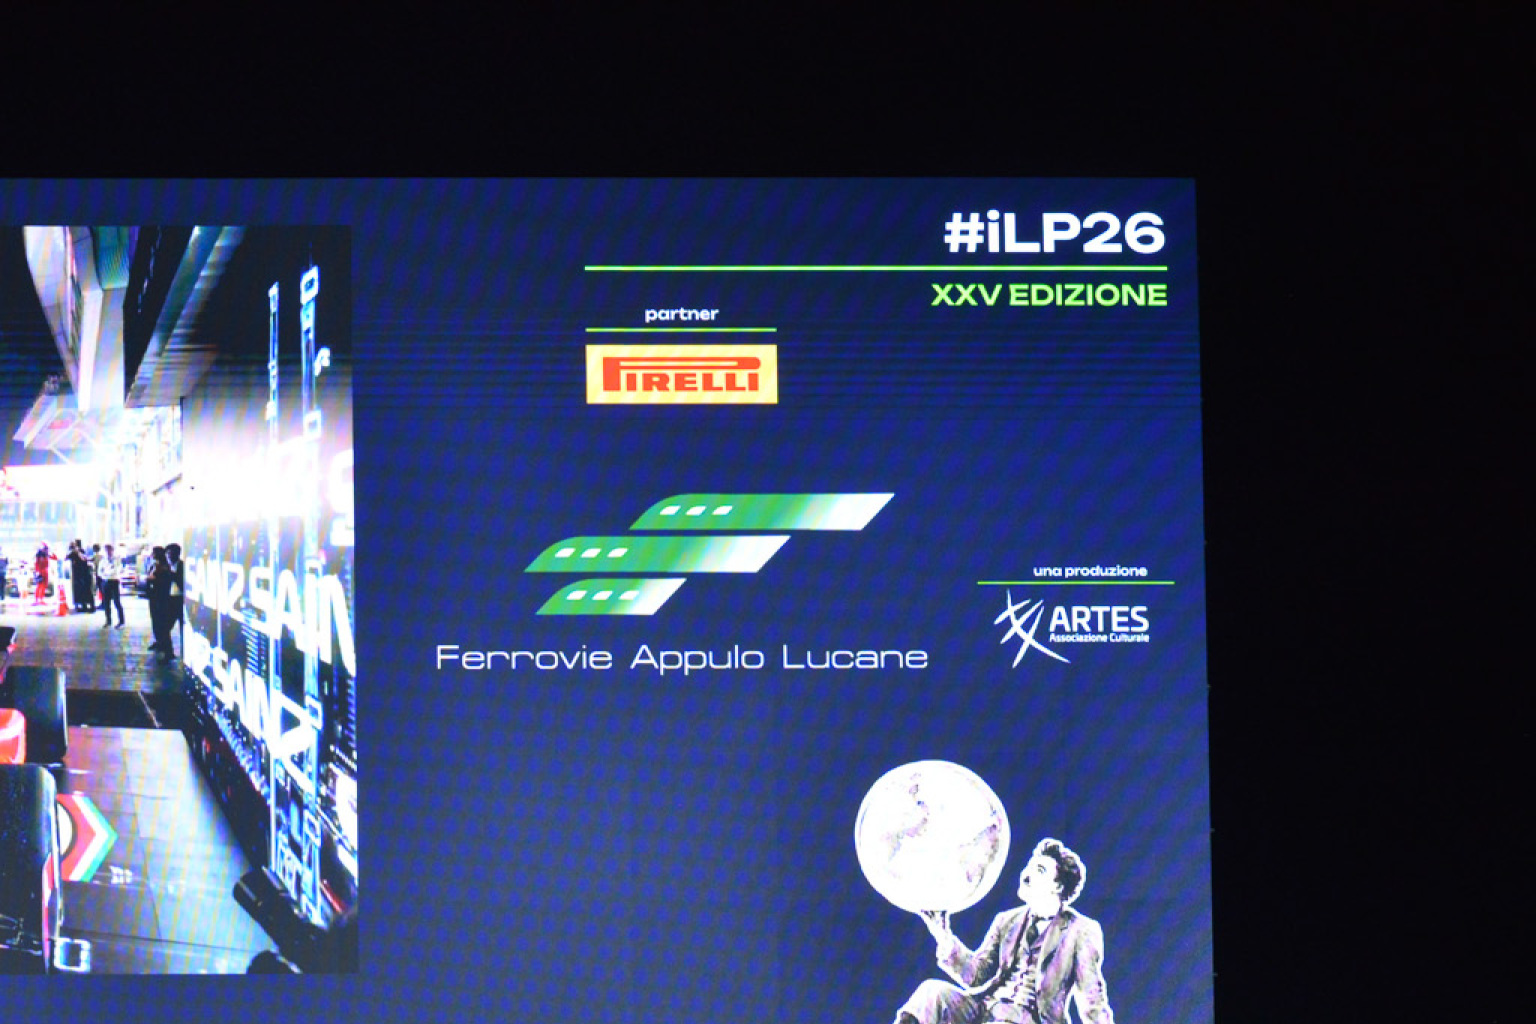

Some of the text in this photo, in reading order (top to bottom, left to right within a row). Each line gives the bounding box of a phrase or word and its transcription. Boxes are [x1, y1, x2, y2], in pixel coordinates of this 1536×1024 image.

[944, 209, 1166, 255] #iLP26
[930, 283, 1168, 307] XXV EDIZIONE
[644, 306, 720, 324] partner
[602, 356, 762, 392] PIRELLI
[1032, 564, 1149, 579] una produzione
[1049, 605, 1150, 633] ARTES
[1049, 632, 1150, 643] Associazione Culturale
[436, 644, 928, 676] Ferrovie Appulo Lucane
